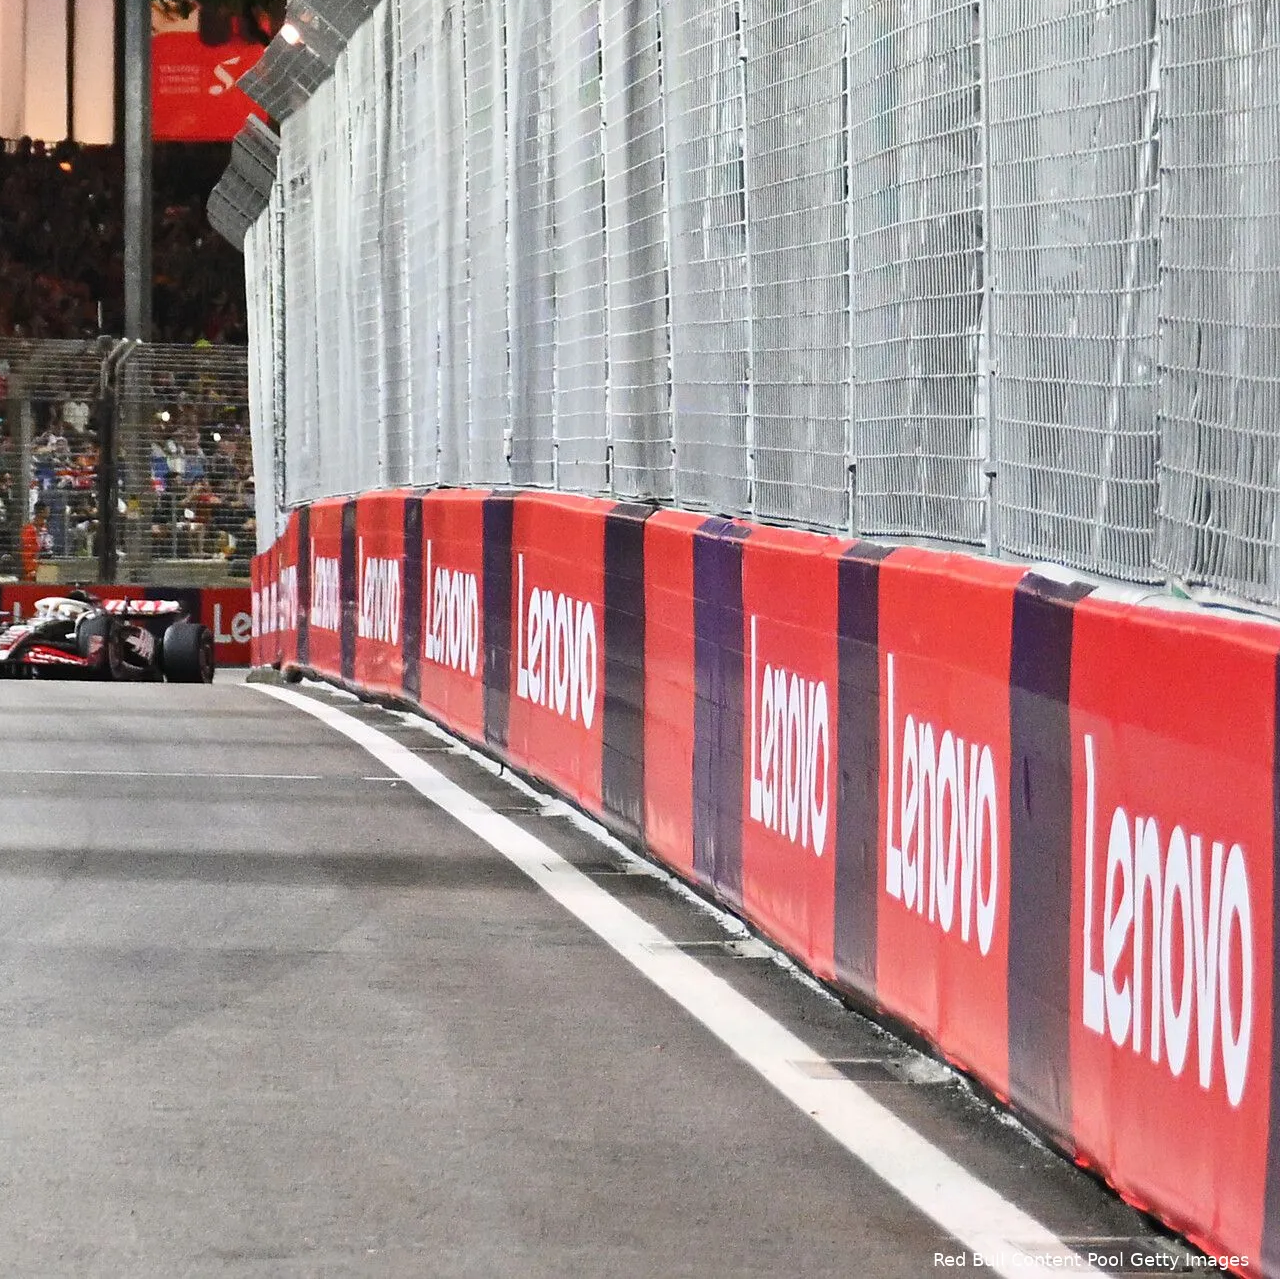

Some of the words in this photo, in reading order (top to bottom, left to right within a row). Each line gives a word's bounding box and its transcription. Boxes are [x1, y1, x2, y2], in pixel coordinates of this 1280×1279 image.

[358, 536, 401, 646] Lenovo
[425, 539, 479, 677] Lenovo
[516, 552, 597, 729] Lenovo
[749, 615, 829, 857] Lenovo
[886, 652, 998, 956] Lenovo
[1083, 734, 1253, 1107] Lenovo
